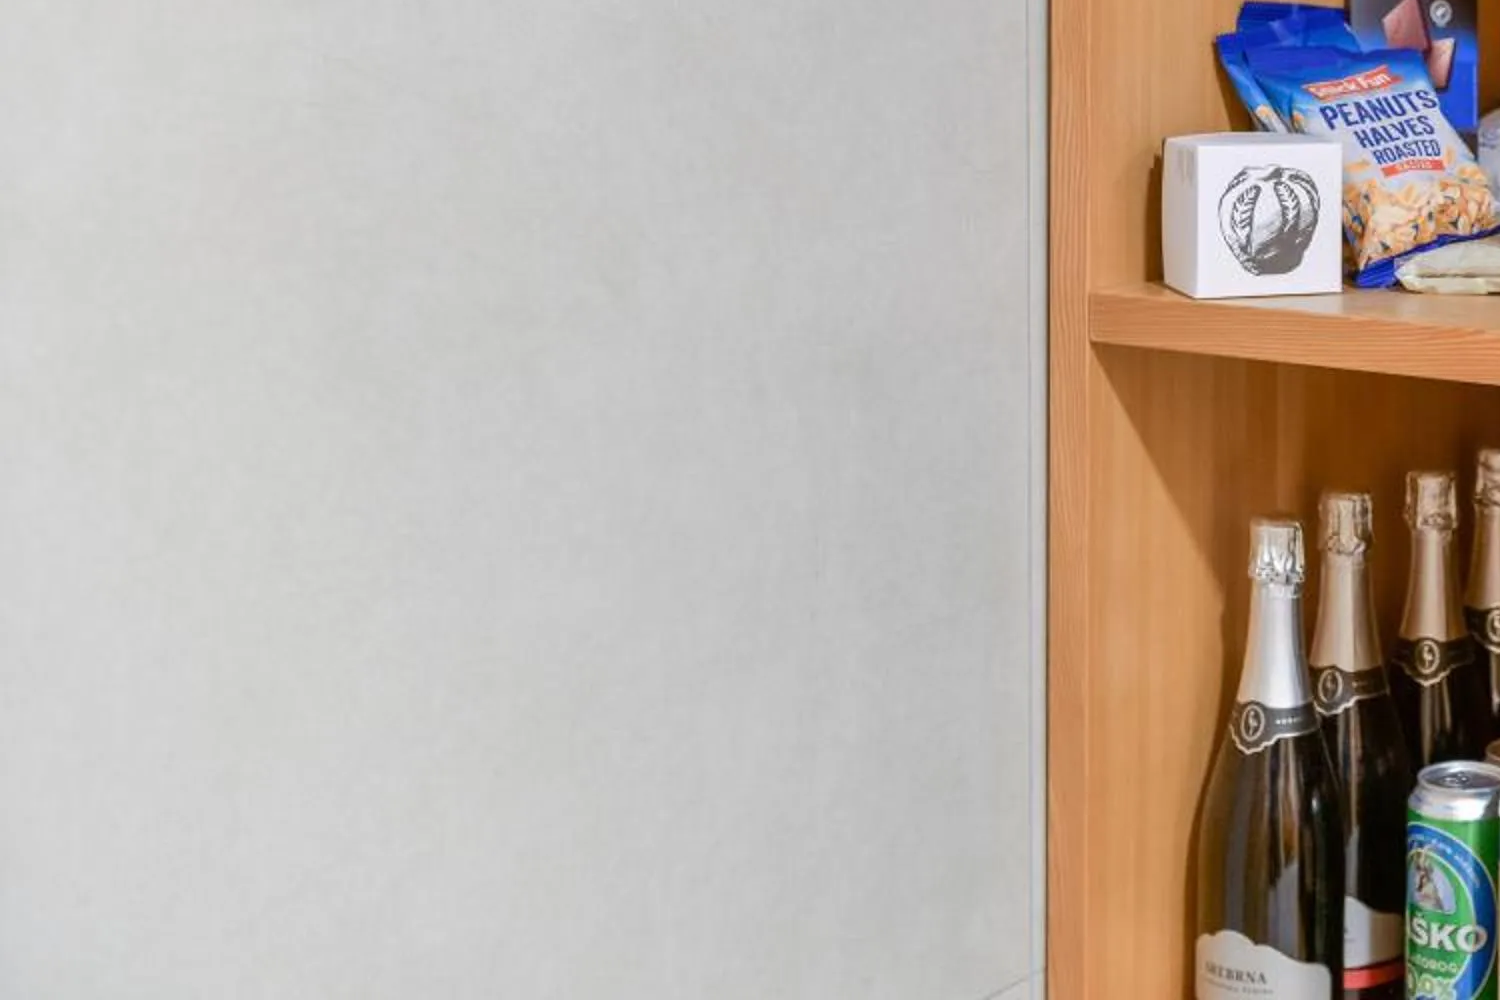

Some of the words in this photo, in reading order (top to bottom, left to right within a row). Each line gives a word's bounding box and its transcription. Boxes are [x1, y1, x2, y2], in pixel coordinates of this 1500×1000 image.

[1318, 88, 1438, 131] PEANUTS
[1353, 115, 1436, 149] HALVES
[1372, 139, 1442, 165] ROASTED
